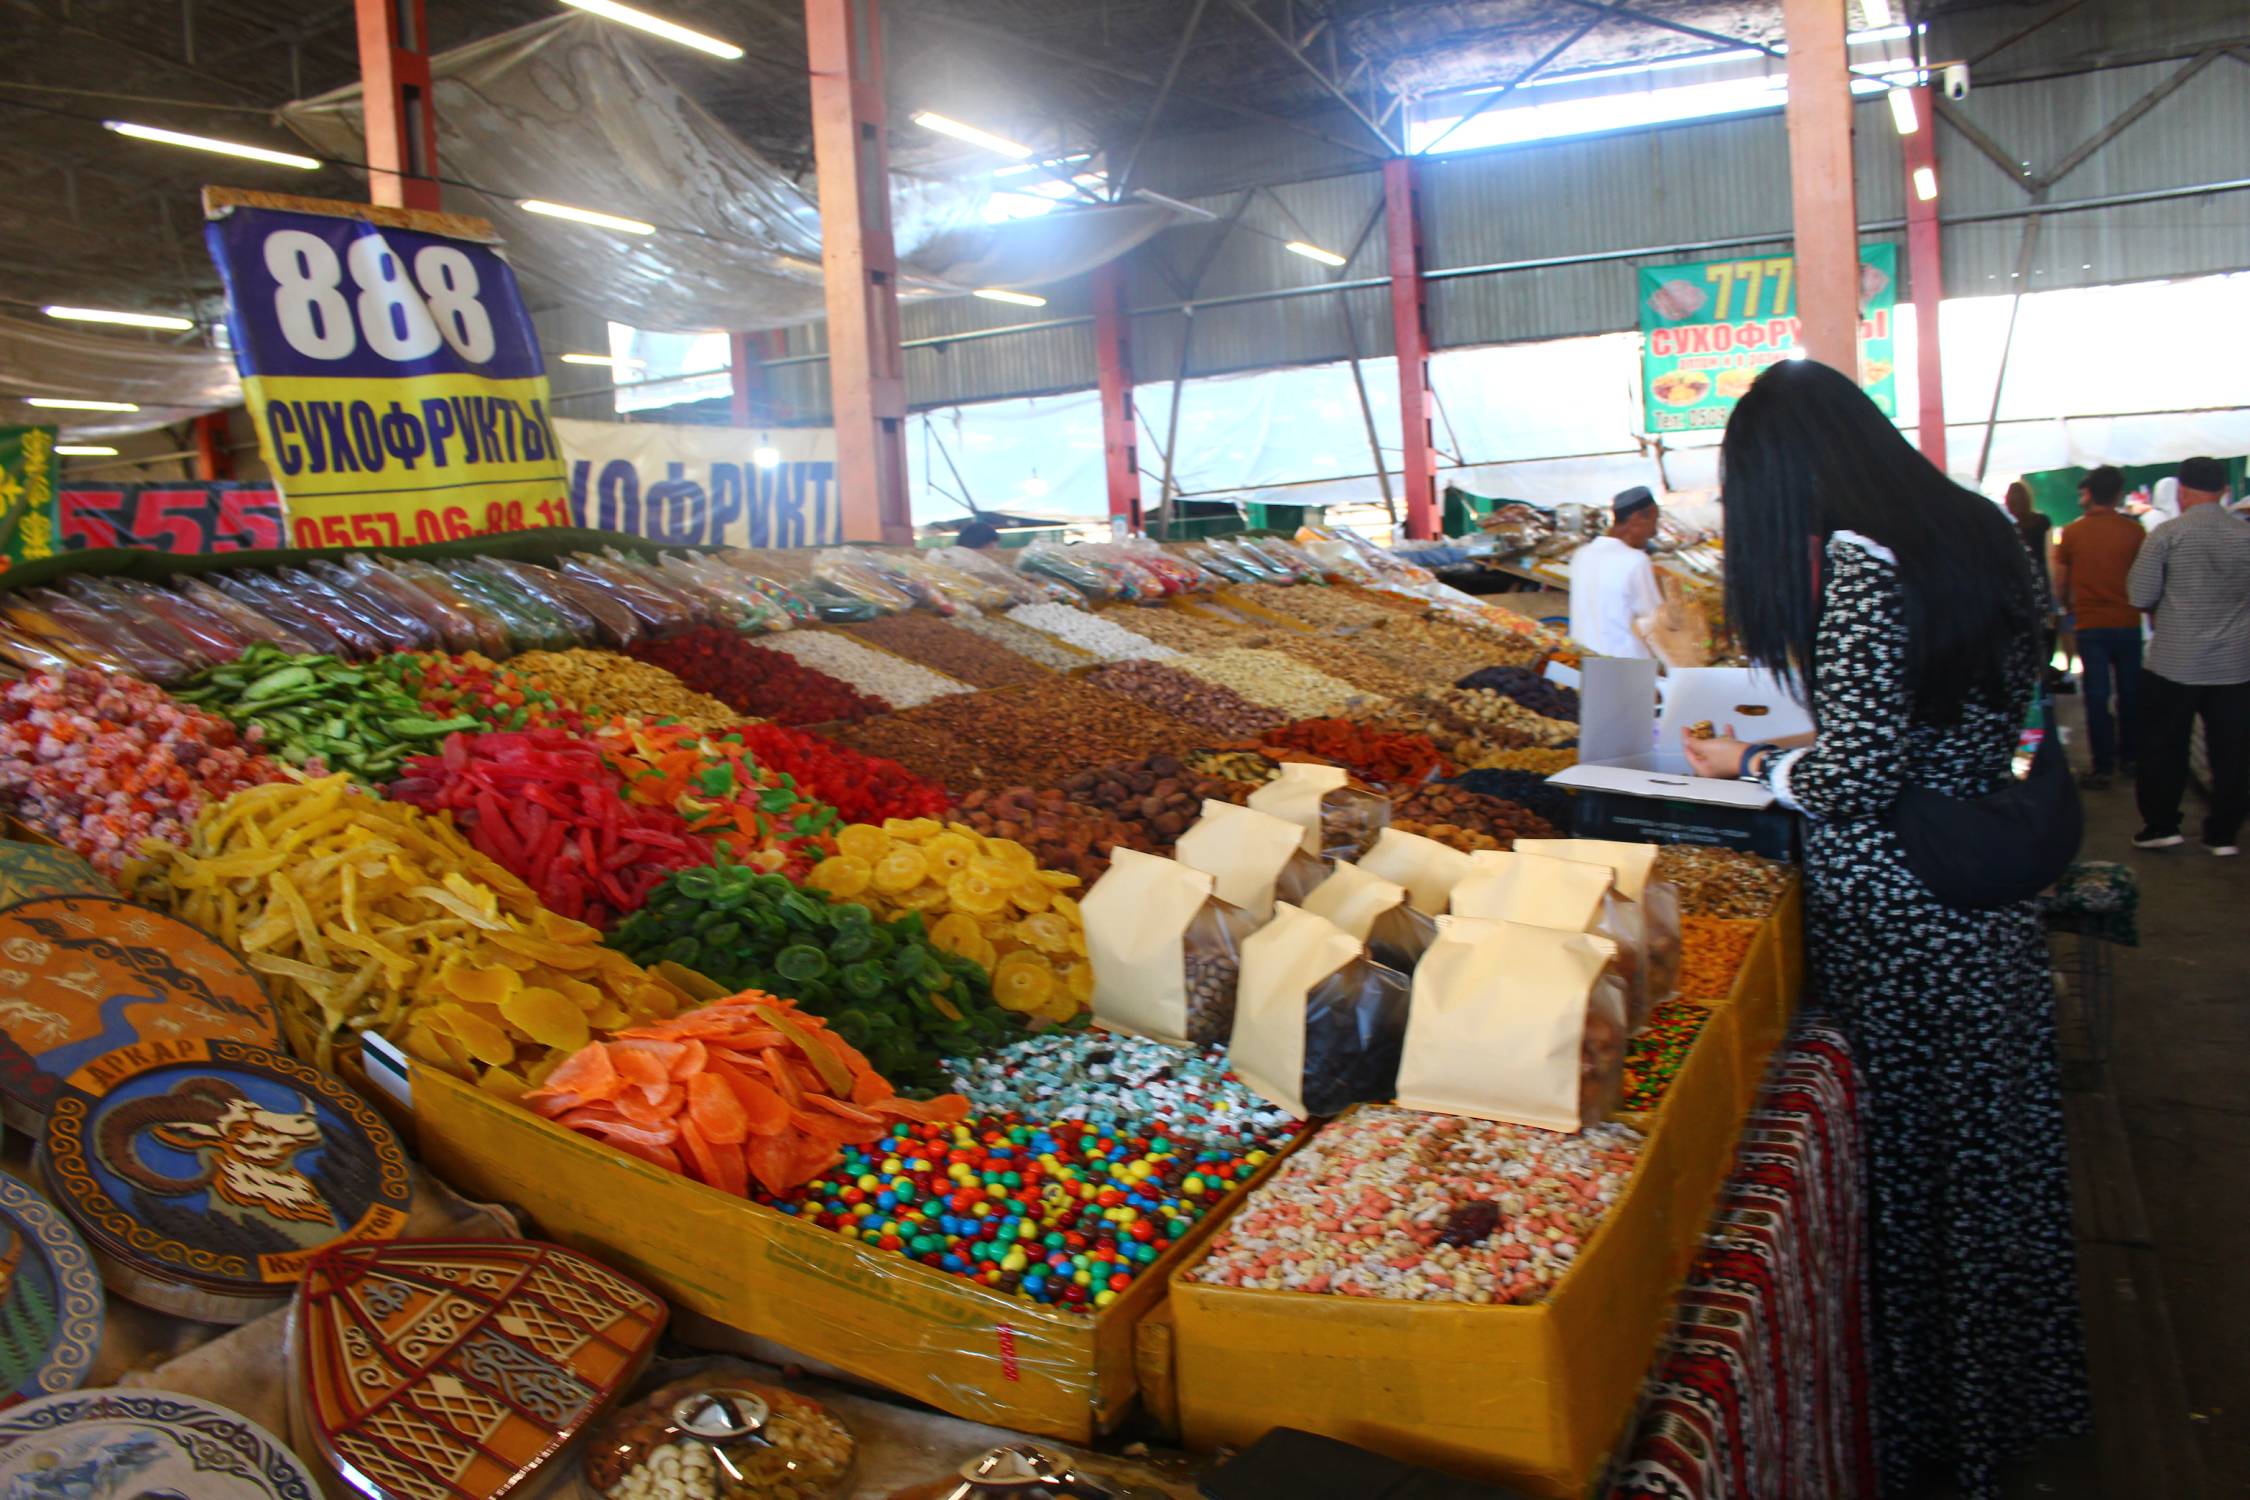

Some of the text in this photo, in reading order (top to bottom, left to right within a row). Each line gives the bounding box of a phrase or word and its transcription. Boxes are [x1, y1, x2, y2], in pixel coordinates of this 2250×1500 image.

[263, 229, 495, 364] 888
[1706, 257, 1793, 320] 777
[1652, 310, 1888, 356] СУХОФРУЫ
[266, 396, 557, 476] СУХОФРУКТЫ
[60, 490, 279, 555] 555
[571, 459, 841, 548] ОФРУКТ
[86, 1039, 195, 1087] АРКАР
